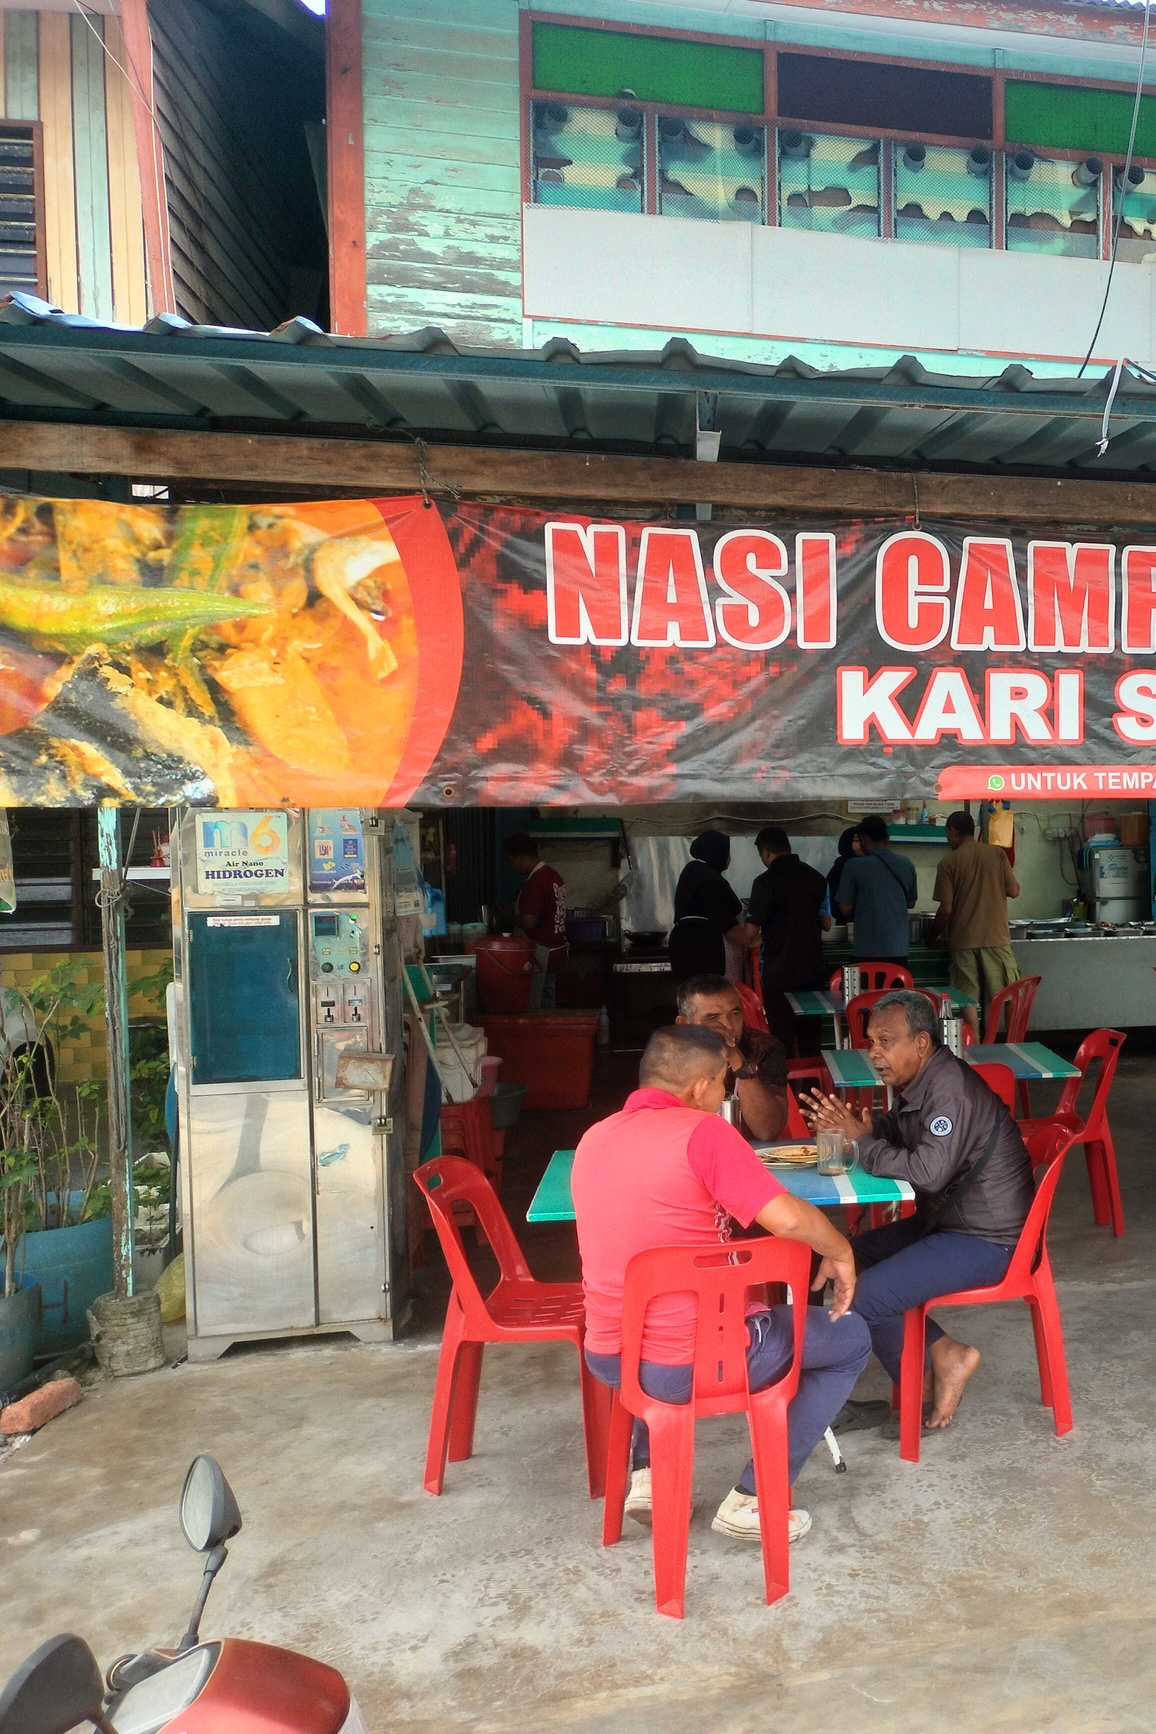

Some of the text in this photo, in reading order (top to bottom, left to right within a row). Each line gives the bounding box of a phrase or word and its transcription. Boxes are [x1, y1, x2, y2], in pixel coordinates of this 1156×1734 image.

[545, 522, 836, 650] NASI
[837, 667, 1084, 745] KARI
[1010, 771, 1088, 791] UNTUK
[204, 849, 248, 857] miracle
[204, 868, 285, 880] HIDROGEN
